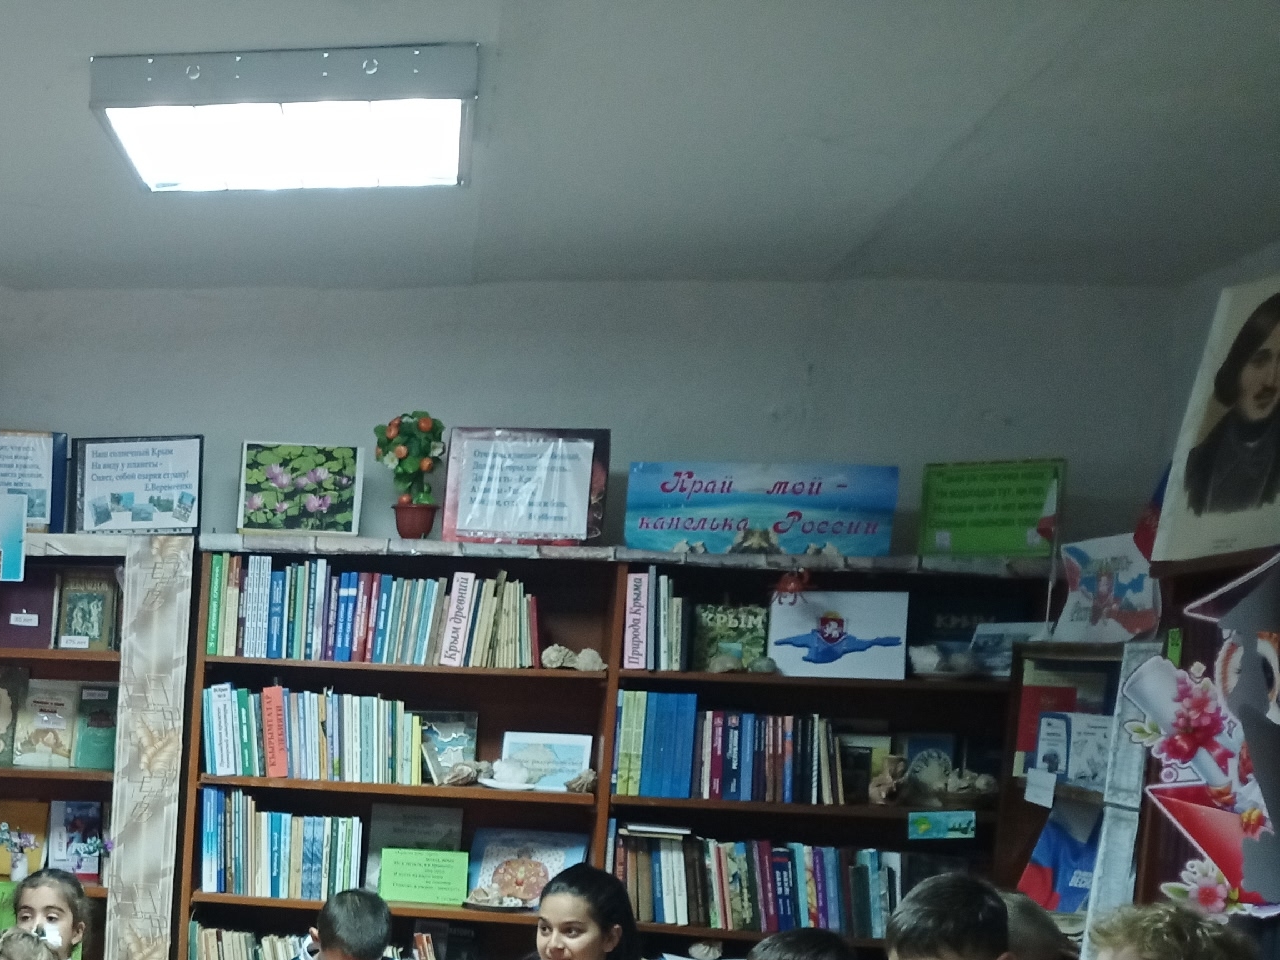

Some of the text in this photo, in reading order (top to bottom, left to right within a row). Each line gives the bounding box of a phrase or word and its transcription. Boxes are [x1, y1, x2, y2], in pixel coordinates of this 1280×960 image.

[92, 450, 108, 458] Наш
[151, 448, 174, 458] Крым
[91, 462, 102, 470] На
[661, 471, 733, 499] Край
[766, 476, 822, 496] мой
[639, 510, 879, 535] капелька России
[443, 576, 470, 662] Крым древний
[628, 577, 643, 665] Природа Крыма
[702, 612, 764, 629] КРЫМ
